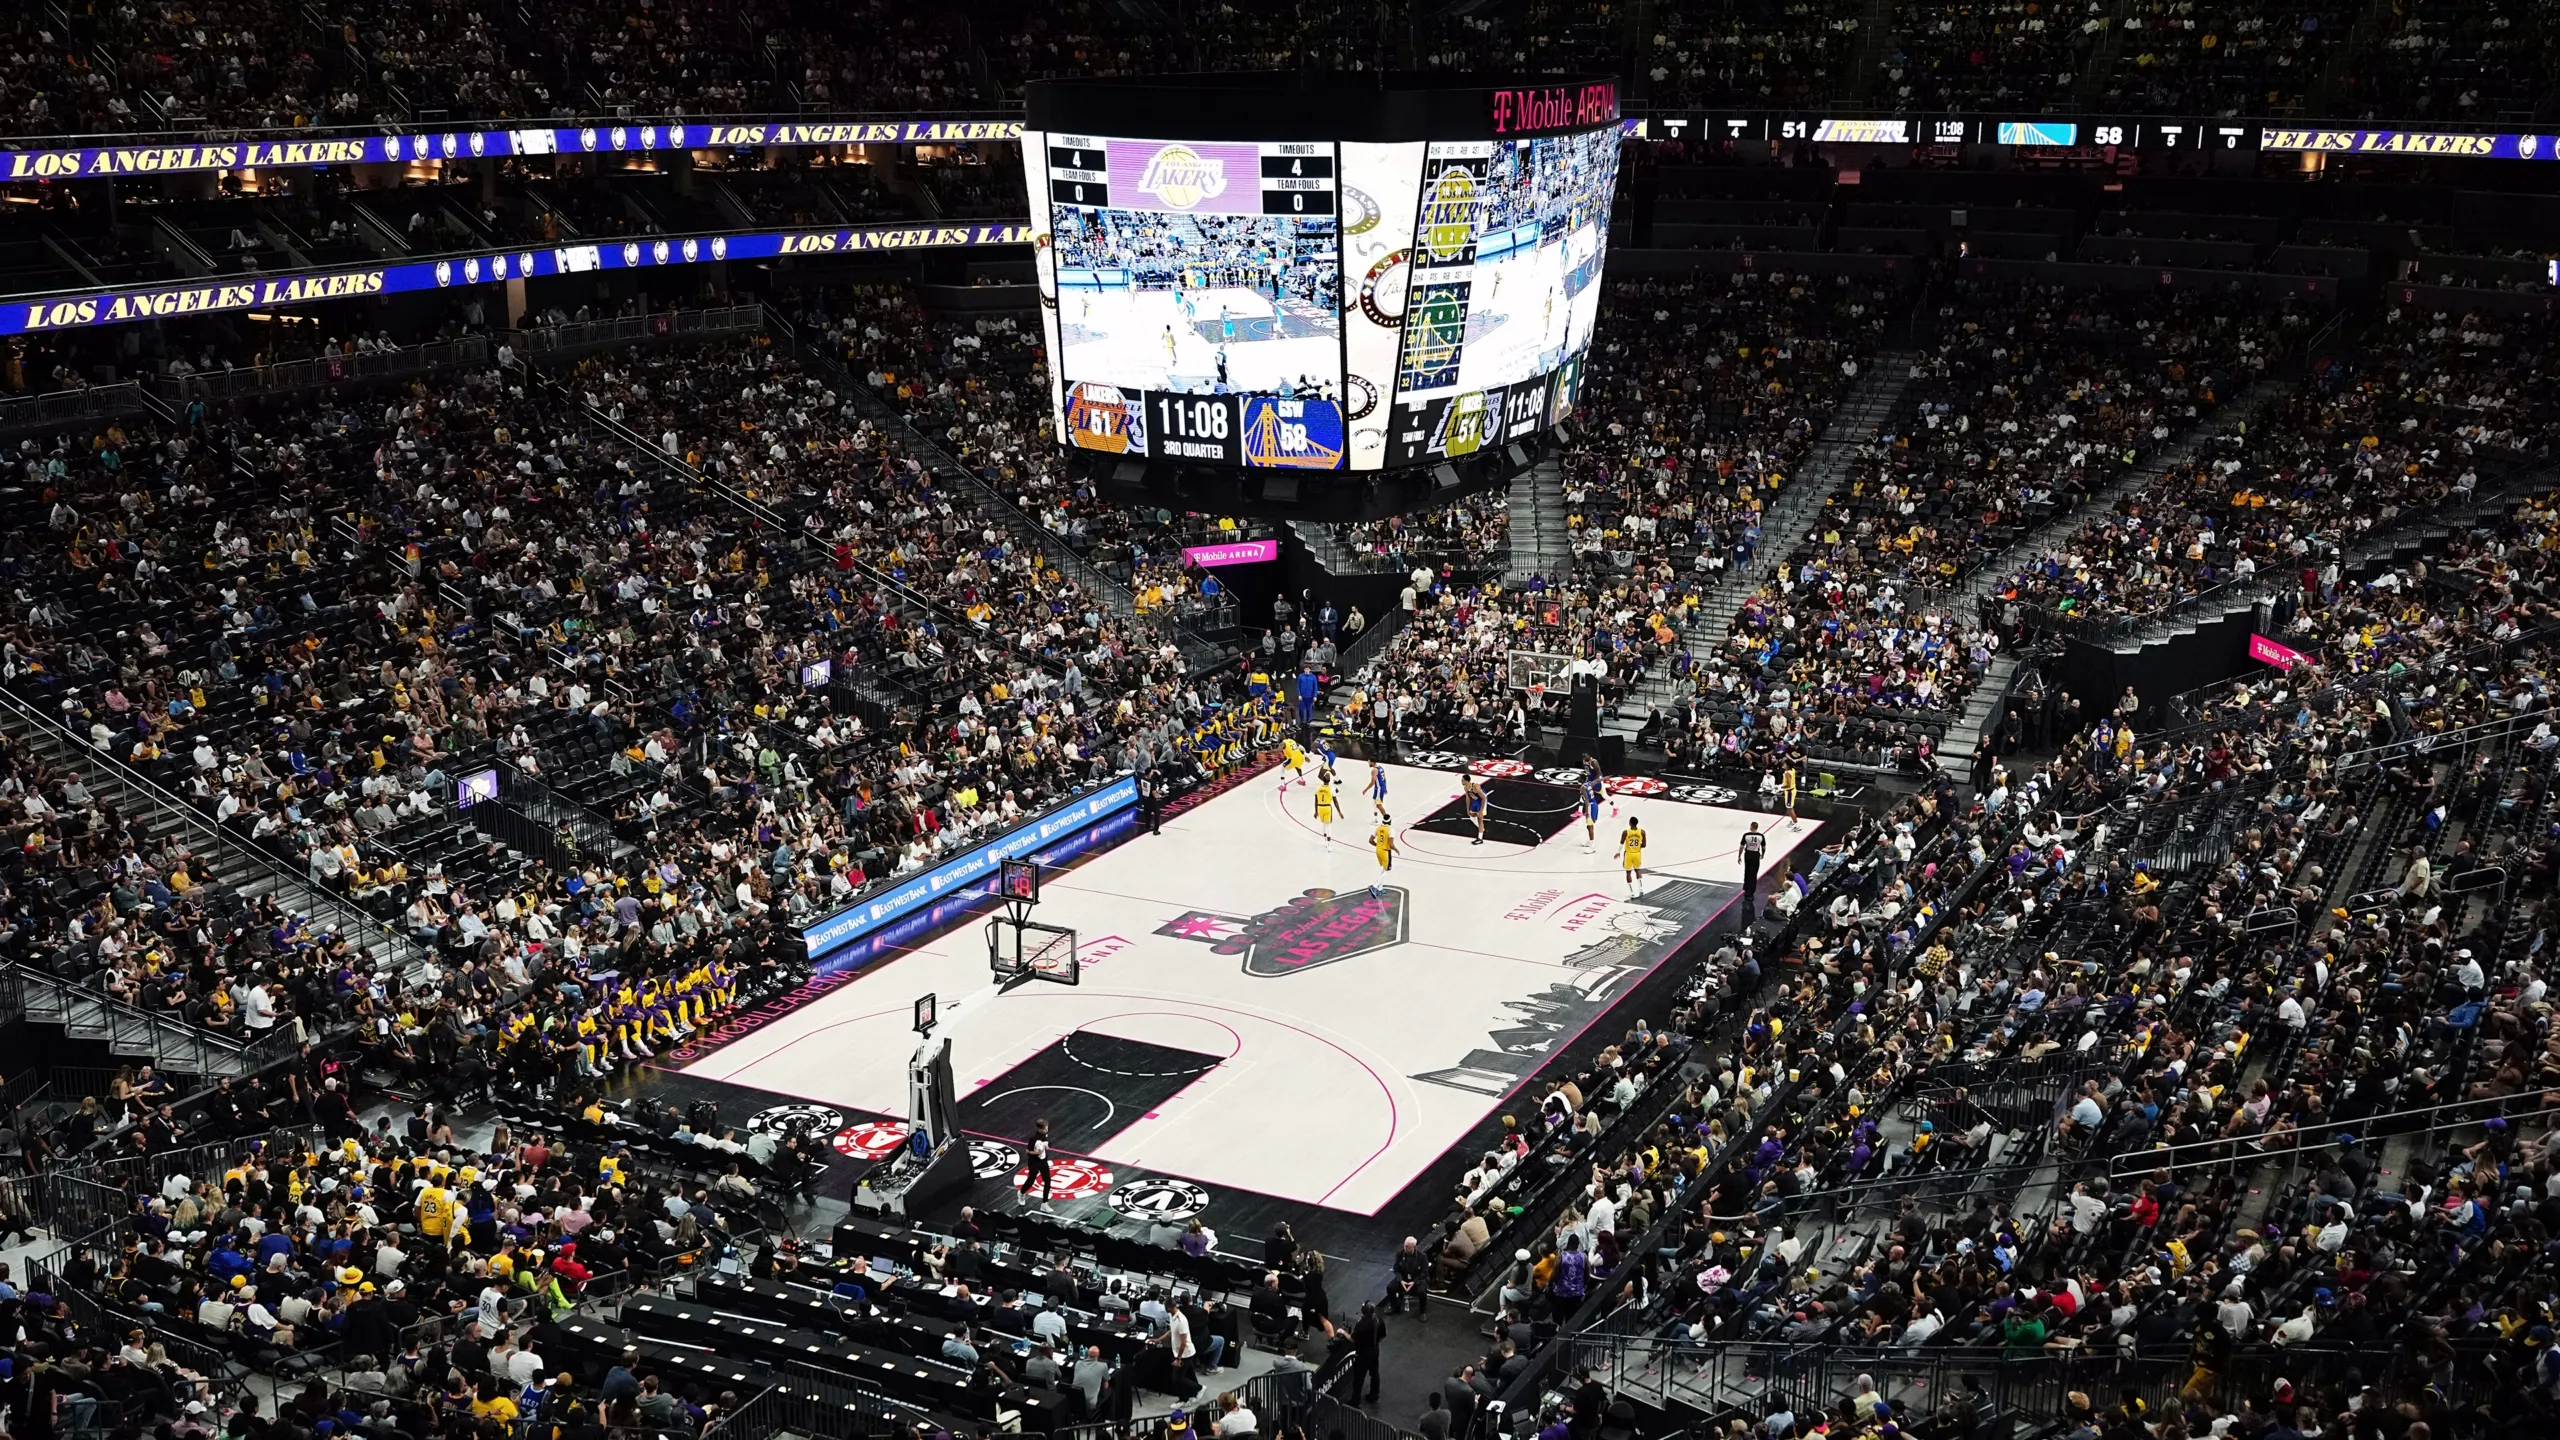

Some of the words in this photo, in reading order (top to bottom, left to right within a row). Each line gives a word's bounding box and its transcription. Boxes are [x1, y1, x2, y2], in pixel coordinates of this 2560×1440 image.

[1576, 84, 1614, 125] ARENA
[708, 125, 766, 145] LOS
[769, 123, 899, 143] ANGELES
[903, 121, 1025, 141] LAKERS
[1671, 127, 1679, 138] 0
[1731, 127, 1739, 138] 4
[1782, 121, 1806, 138] 51
[1935, 121, 1963, 135] 11:08
[2095, 126, 2122, 144] 58
[2166, 134, 2175, 146] 5
[2227, 136, 2236, 148] 0
[2358, 134, 2496, 155] LAKERS
[9, 153, 81, 177] LOS
[88, 145, 239, 175] ANGELES
[243, 139, 365, 167] LAKERS
[1279, 144, 1315, 155] TIMEOUTS
[1072, 151, 1081, 168] 4
[1291, 159, 1302, 176] 4
[1145, 161, 1219, 194] LAKERS
[1277, 179, 1297, 189] TEAM
[1298, 180, 1320, 190] FOULS
[1075, 185, 1084, 202] 0
[1293, 194, 1304, 211] 0
[779, 233, 837, 254] LOS
[841, 228, 971, 251] ANGELES
[25, 301, 98, 329] LOS
[104, 283, 255, 322] ANGELES
[262, 271, 384, 304] LAKERS
[657, 322, 668, 333] 14
[330, 363, 341, 377] 15
[1508, 385, 1546, 424] 11:08
[1090, 408, 1112, 438] 51
[1158, 398, 1229, 439] 11:08
[1412, 415, 1419, 428] 4
[1280, 423, 1307, 452] 58
[1457, 416, 1477, 443] 51
[1163, 440, 1181, 456] 3RD
[1182, 442, 1224, 460] QUARTER
[1408, 446, 1415, 458] 0
[1229, 549, 1259, 559] ARENA
[1691, 789, 1716, 799] S
[1629, 838, 1639, 847] 28
[1014, 876, 1031, 897] 18
[1560, 901, 1611, 932] ARENA
[1274, 939, 1330, 966] LAS
[1312, 899, 1393, 938] VEGAS
[668, 968, 861, 1061] @TMOBILEARENA
[424, 1200, 437, 1214] 23
[480, 1300, 491, 1314] 30
[522, 1397, 540, 1408] WEST
